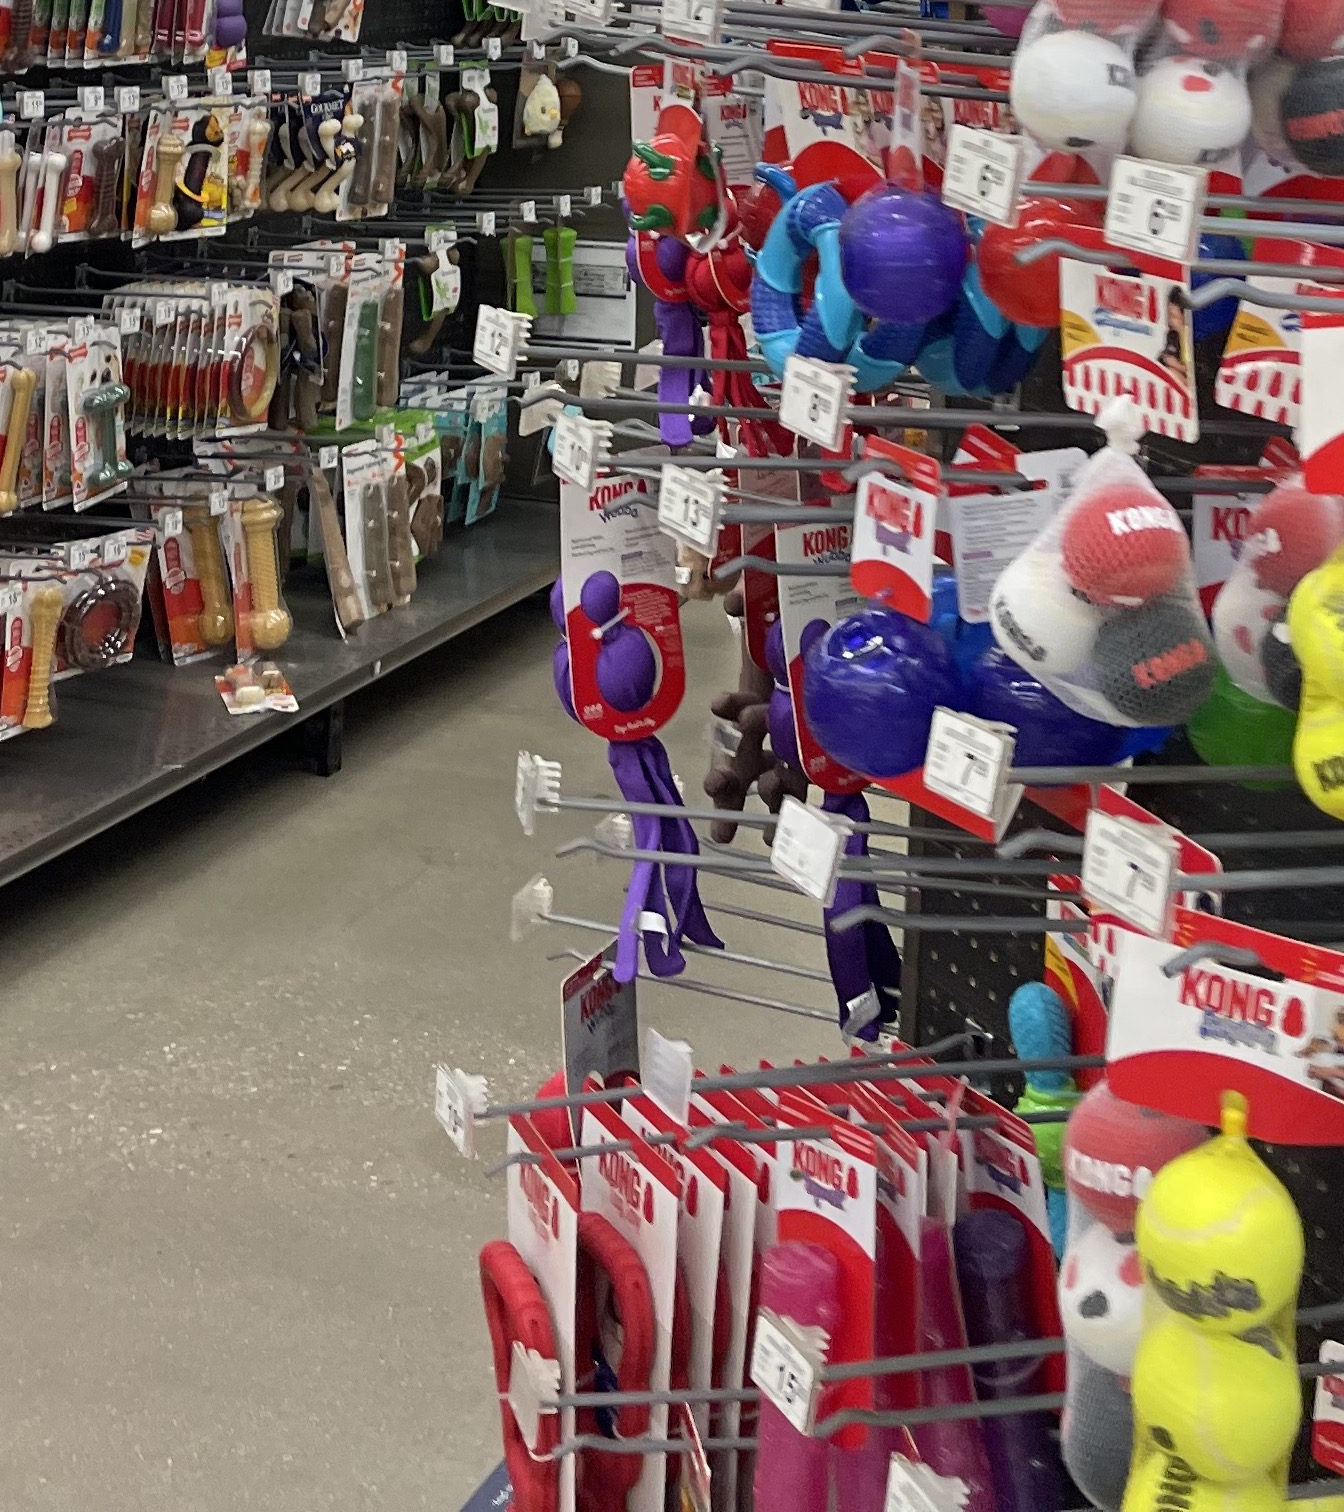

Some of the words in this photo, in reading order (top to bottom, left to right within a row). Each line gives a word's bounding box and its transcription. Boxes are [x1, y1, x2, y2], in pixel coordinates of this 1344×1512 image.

[802, 525, 849, 556] KONG
[1176, 967, 1278, 1026] KONG
[792, 1140, 844, 1186] KONG
